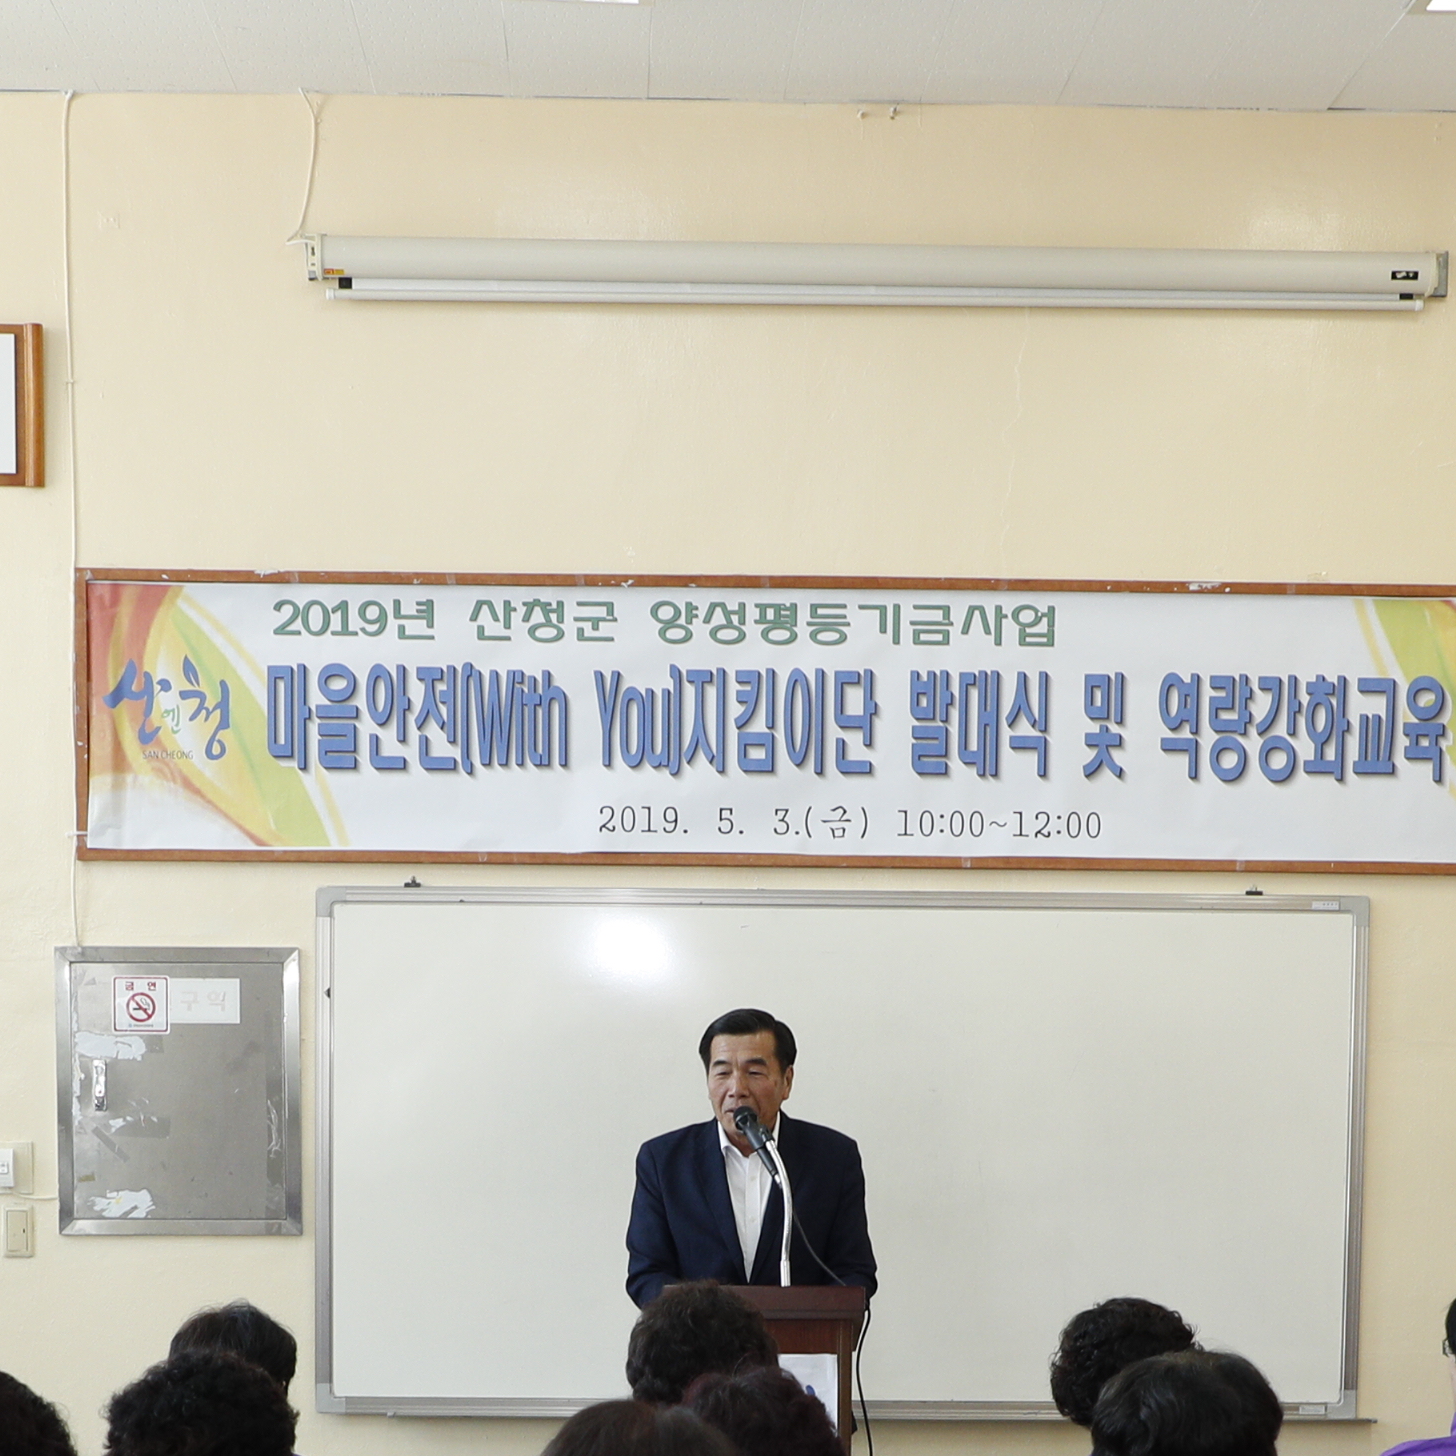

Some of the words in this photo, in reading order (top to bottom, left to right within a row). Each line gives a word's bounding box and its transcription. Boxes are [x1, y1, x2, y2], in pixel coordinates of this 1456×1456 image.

[272, 598, 435, 640] 2019년
[469, 598, 618, 642] 산청군
[649, 599, 1056, 647] 양성평등기금사업
[266, 661, 570, 775] 마을안전(With
[593, 662, 878, 776] You)지킴이단
[909, 669, 1049, 777] 발대식
[1082, 671, 1125, 779] 및
[1158, 672, 1445, 783] 역량강화교육
[142, 750, 159, 760] SAN
[160, 750, 194, 760] CHEONG
[598, 804, 690, 835] 2019.
[717, 806, 745, 836] 5.
[773, 805, 870, 840] 3.(금)
[896, 808, 1103, 839] 10:00~12:00
